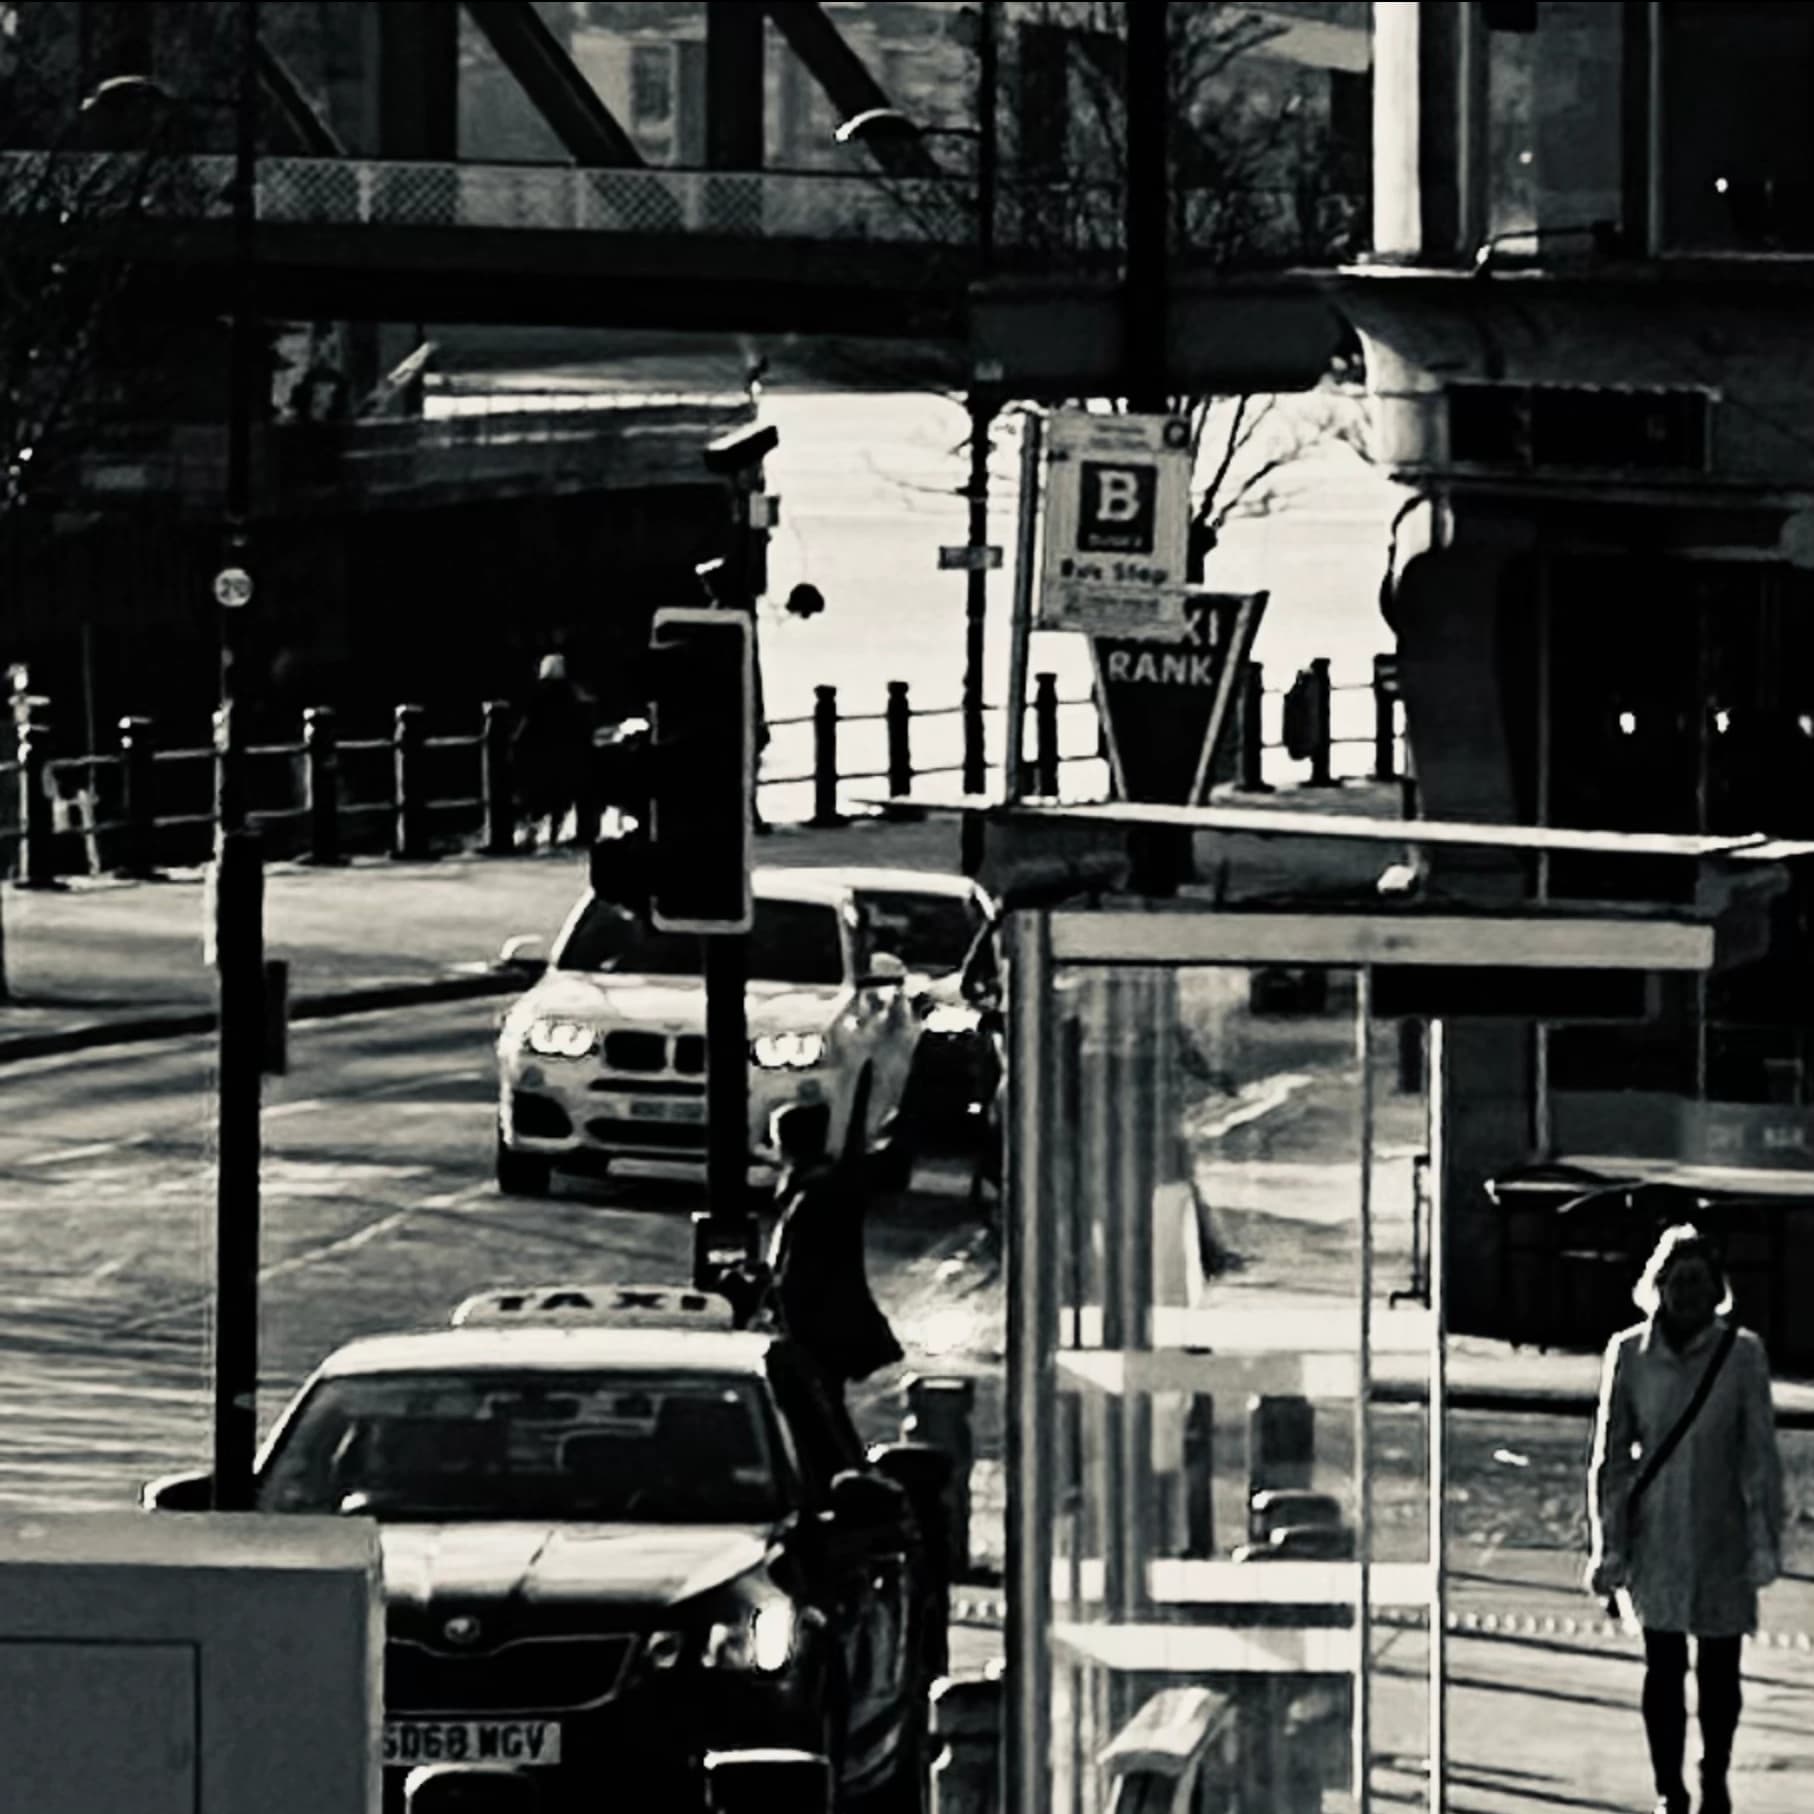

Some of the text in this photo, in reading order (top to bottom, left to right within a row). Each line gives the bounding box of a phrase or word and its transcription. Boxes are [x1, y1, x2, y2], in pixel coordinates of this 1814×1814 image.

[1096, 470, 1140, 521] B
[1183, 608, 1220, 647] XI
[1107, 650, 1213, 686] RANK
[492, 1291, 709, 1311] TAXI
